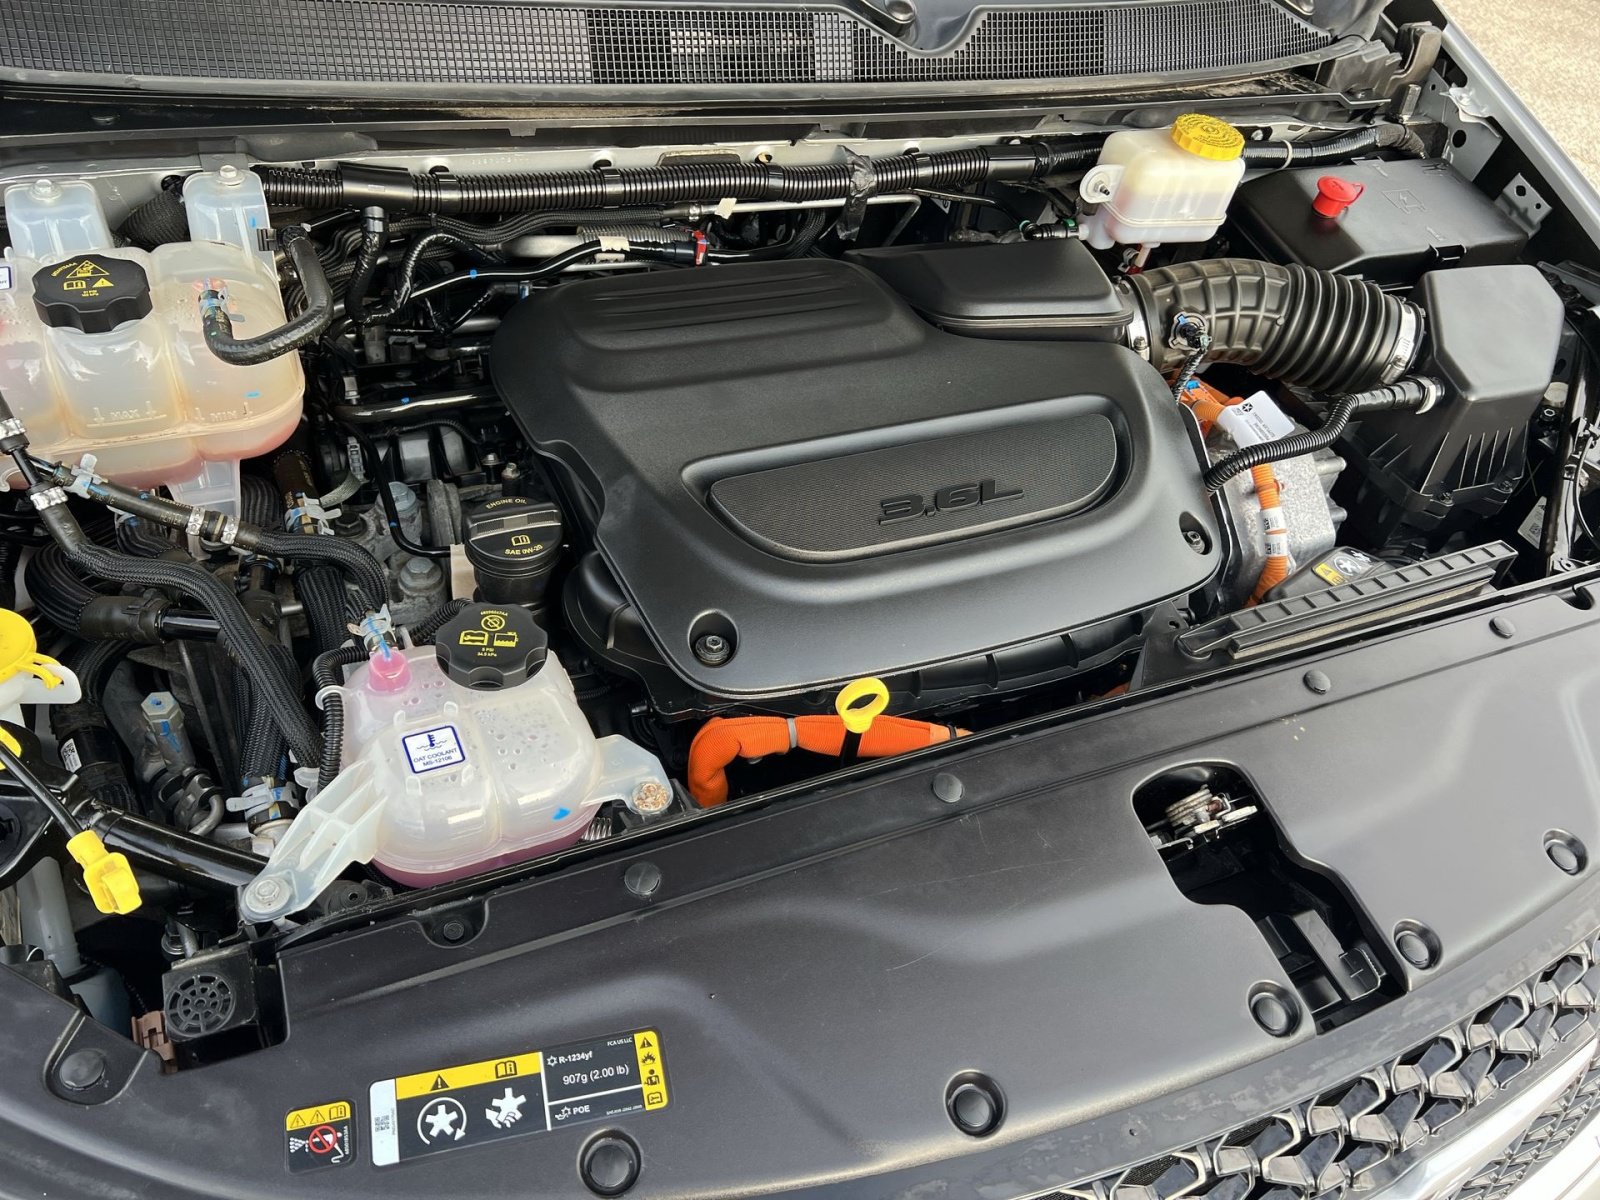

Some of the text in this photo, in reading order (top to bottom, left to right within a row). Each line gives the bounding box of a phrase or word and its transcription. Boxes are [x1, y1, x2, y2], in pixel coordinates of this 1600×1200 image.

[110, 409, 138, 418] MAX
[210, 411, 236, 421] MIN
[486, 499, 513, 509] ENGINE
[878, 479, 1024, 526] 3.6L
[522, 544, 543, 554] 0W-20
[427, 748, 457, 759] COOLANT
[423, 755, 453, 766] MS-12106
[559, 1051, 593, 1064] R-1234yf
[563, 1064, 630, 1085] 907g (2.00 lb)
[573, 1105, 590, 1115] POE
